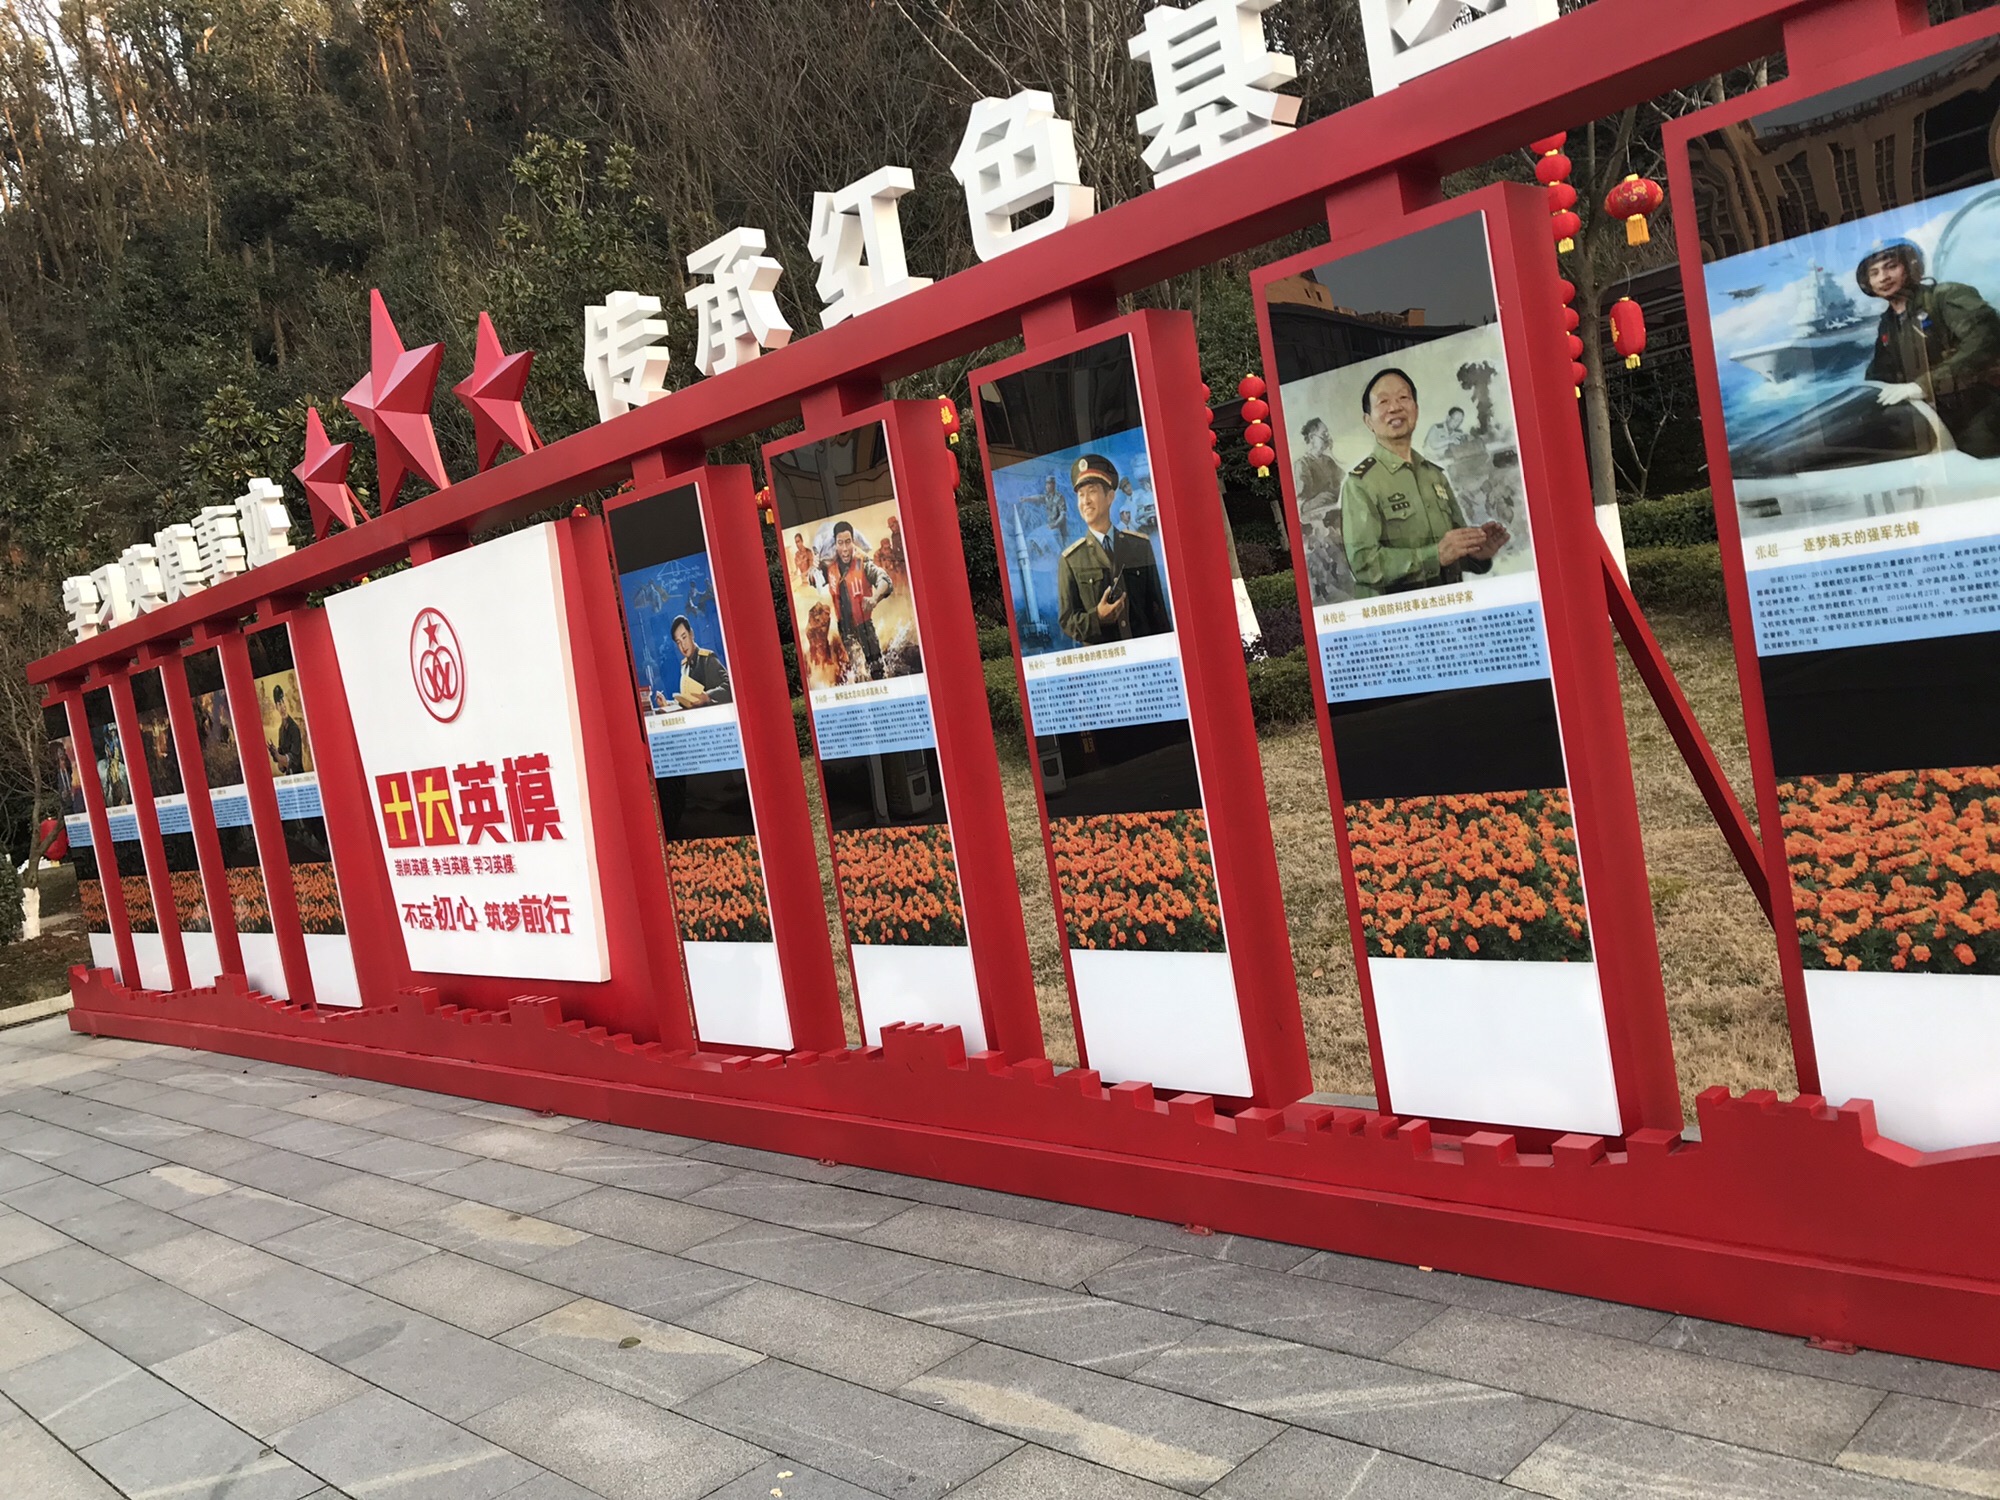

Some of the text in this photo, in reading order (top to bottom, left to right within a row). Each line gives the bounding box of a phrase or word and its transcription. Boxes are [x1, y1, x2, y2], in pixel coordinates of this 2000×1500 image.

[62, 477, 296, 644] 学习英模事迹
[378, 752, 564, 848] 十大英模
[394, 854, 516, 876] 崇尚英模 争当英模 学习英模
[401, 893, 571, 934] 不忘初心 筑梦前行
